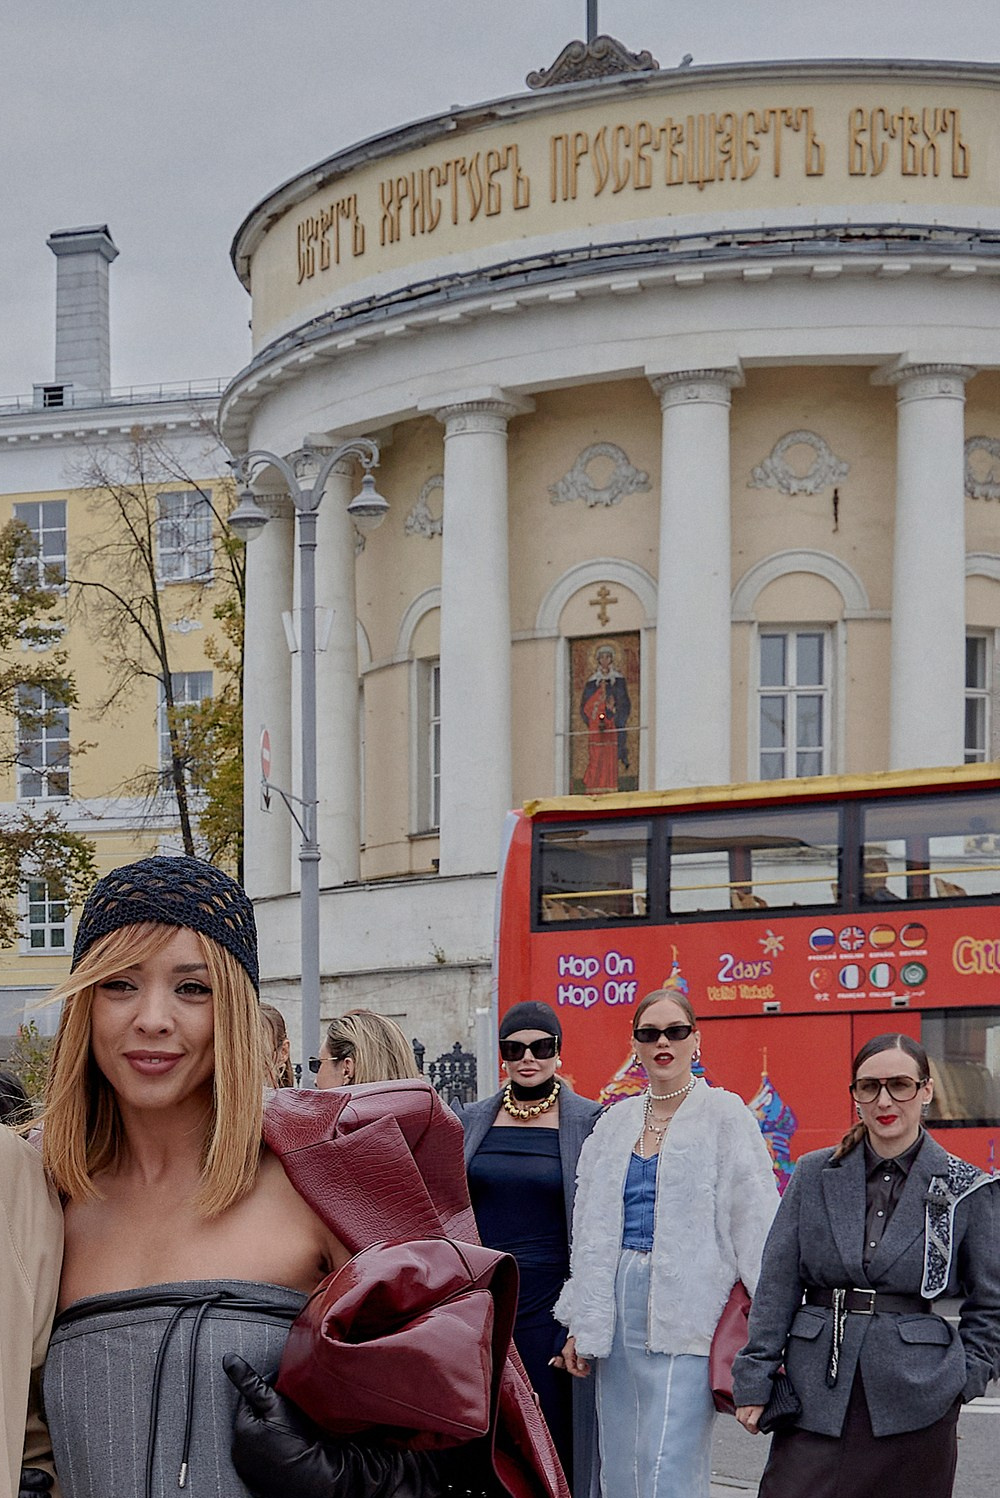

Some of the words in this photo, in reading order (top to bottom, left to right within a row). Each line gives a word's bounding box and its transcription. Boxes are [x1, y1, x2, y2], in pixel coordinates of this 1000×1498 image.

[558, 955, 600, 979] Hop
[604, 951, 634, 976] On
[558, 984, 599, 1008] Hop
[604, 981, 637, 1006] Off
